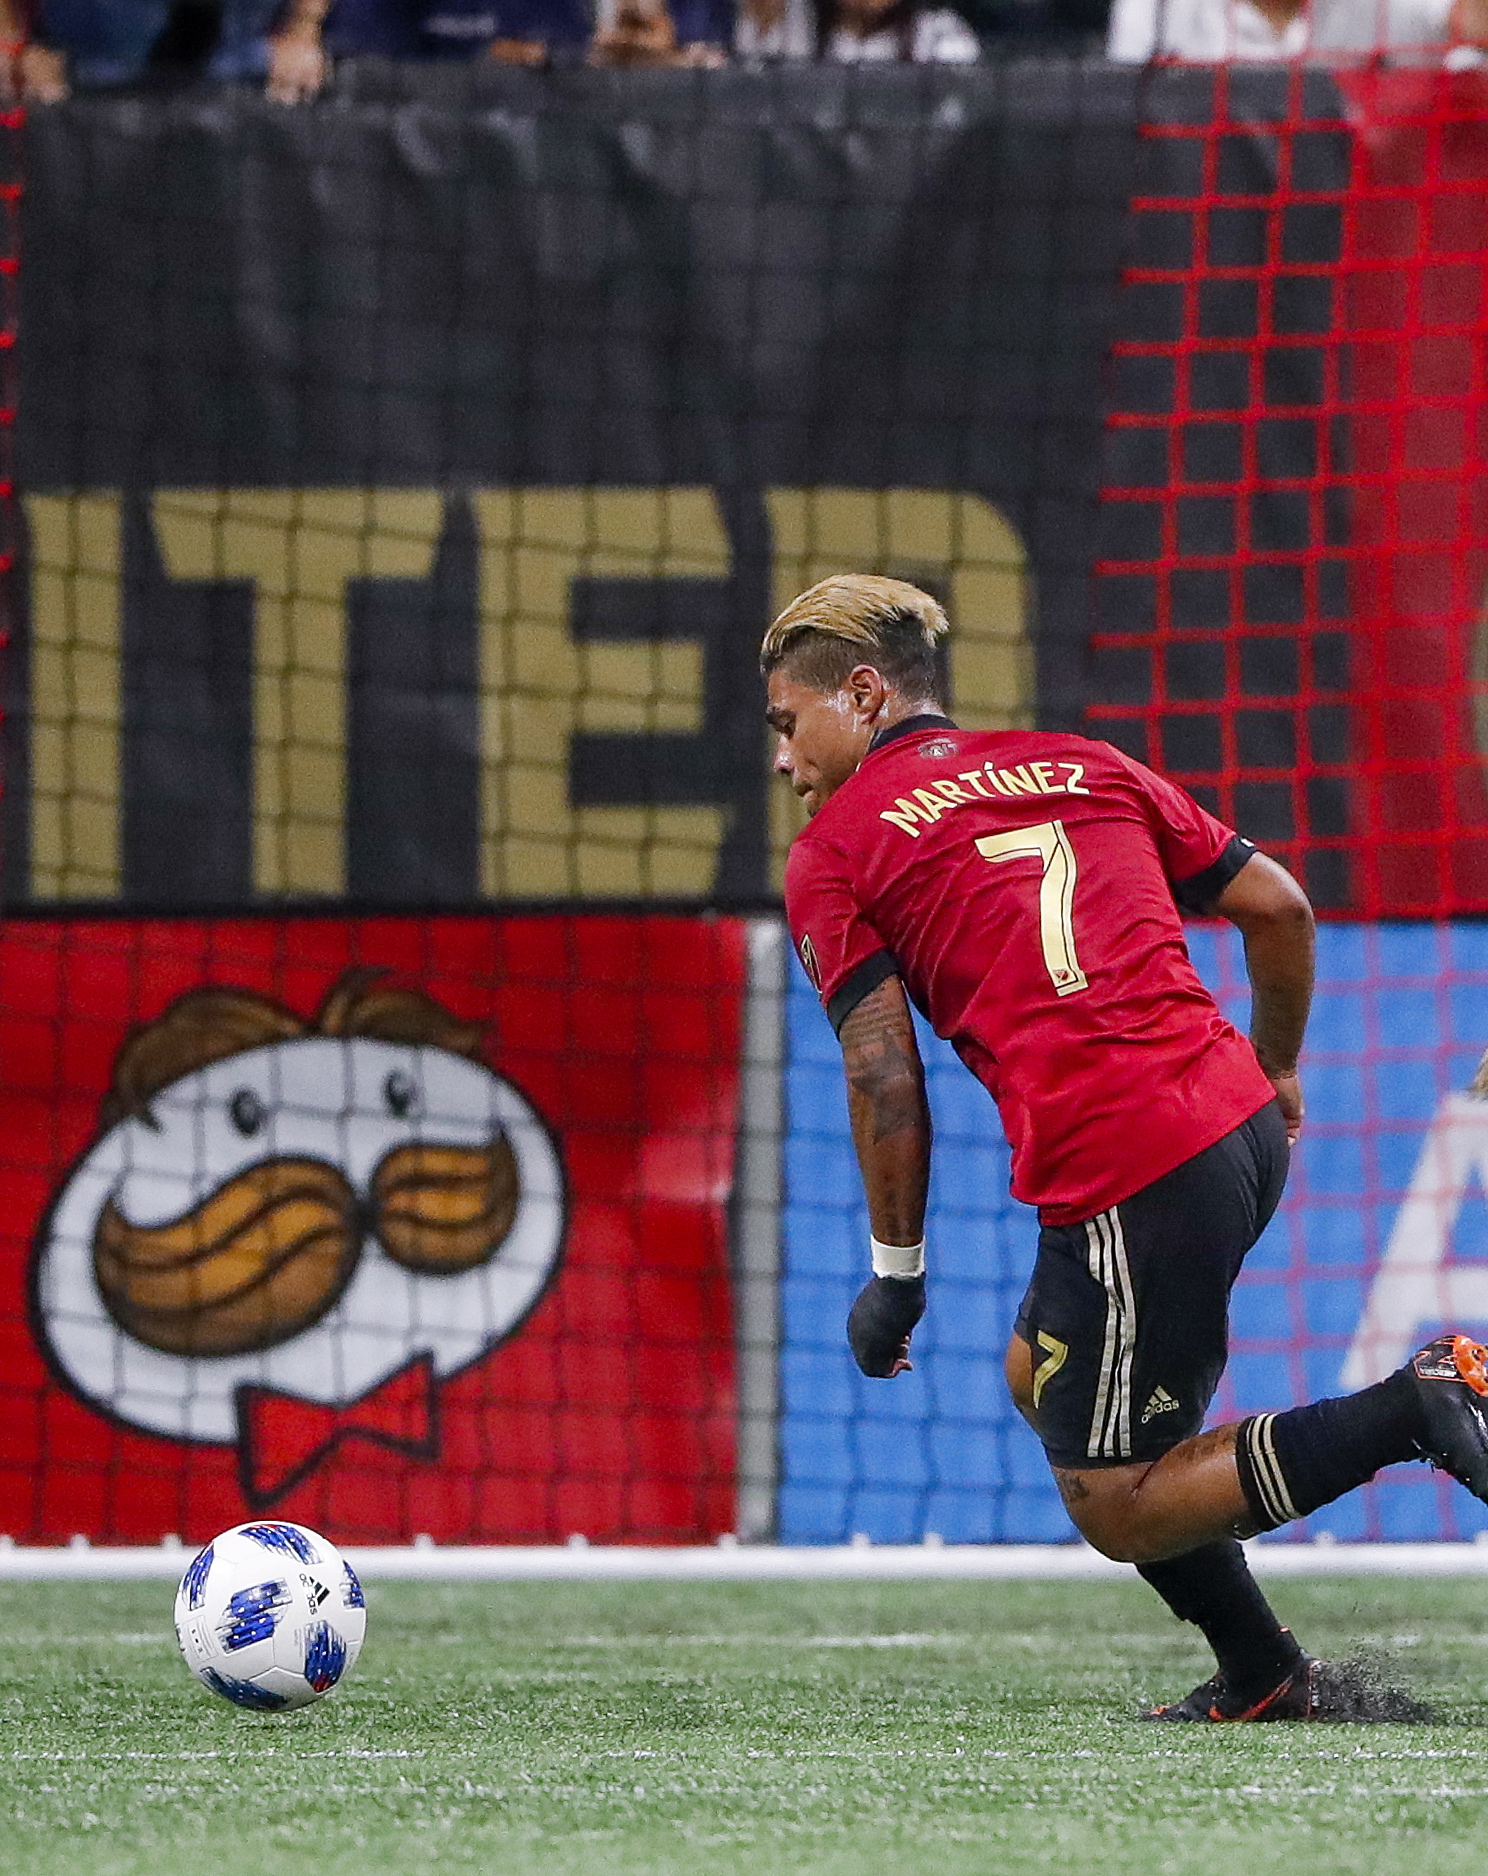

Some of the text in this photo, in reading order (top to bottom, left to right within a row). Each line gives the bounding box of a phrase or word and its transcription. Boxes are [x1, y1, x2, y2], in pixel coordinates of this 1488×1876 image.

[880, 761, 1090, 838] MARTÍNEZ
[974, 819, 1090, 997] 7
[1033, 1329, 1070, 1410] 7
[299, 1573, 317, 1615] addas
